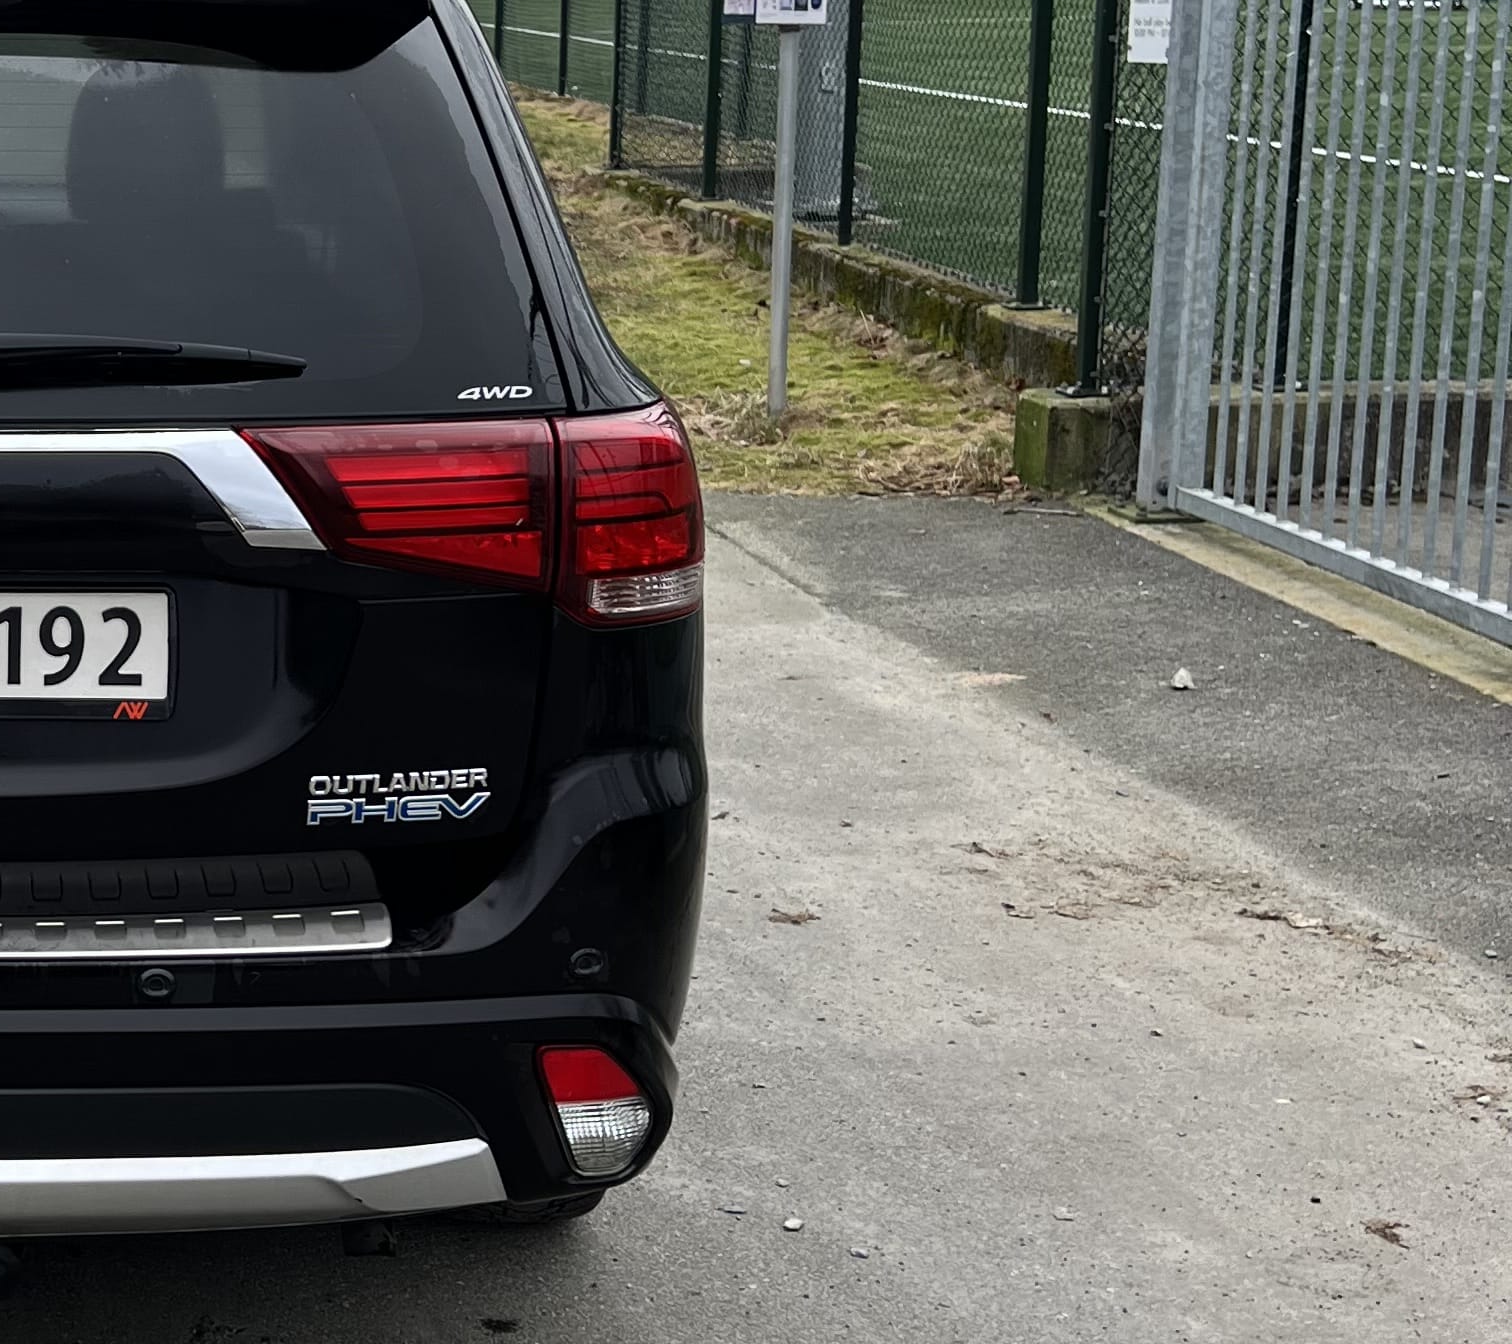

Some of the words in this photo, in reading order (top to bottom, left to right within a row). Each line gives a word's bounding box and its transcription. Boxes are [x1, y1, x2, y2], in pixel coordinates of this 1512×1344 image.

[457, 385, 533, 400] 4WD
[309, 768, 488, 795] OUTLANDER
[306, 791, 491, 825] PHEV
